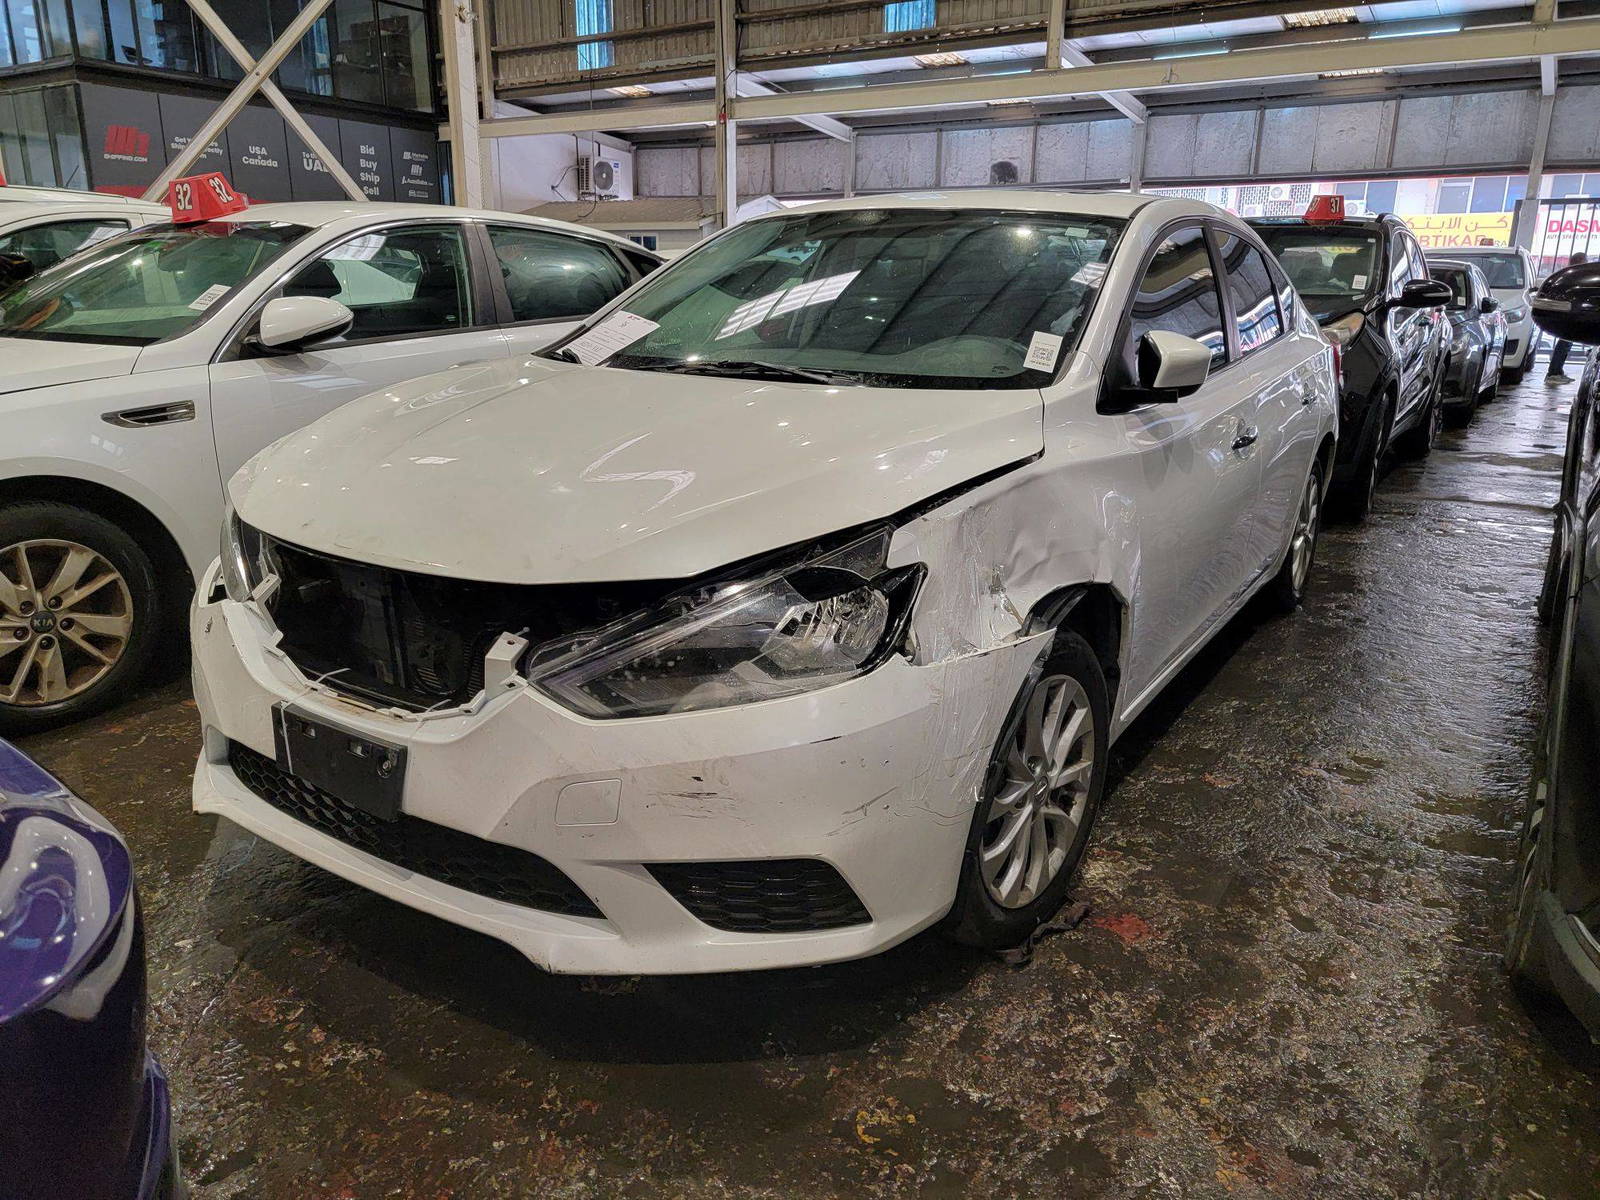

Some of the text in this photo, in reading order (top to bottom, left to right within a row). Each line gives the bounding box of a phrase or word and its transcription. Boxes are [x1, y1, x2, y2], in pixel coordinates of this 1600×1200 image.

[248, 145, 268, 155] USA
[360, 144, 375, 155] Bid
[242, 156, 278, 168] Canada
[360, 158, 378, 171] Buy
[360, 172, 380, 185] Ship
[208, 176, 234, 203] 32
[363, 185, 380, 196] Sell
[175, 183, 193, 210] 32
[1330, 197, 1340, 213] 37
[33, 618, 54, 627] KIA
